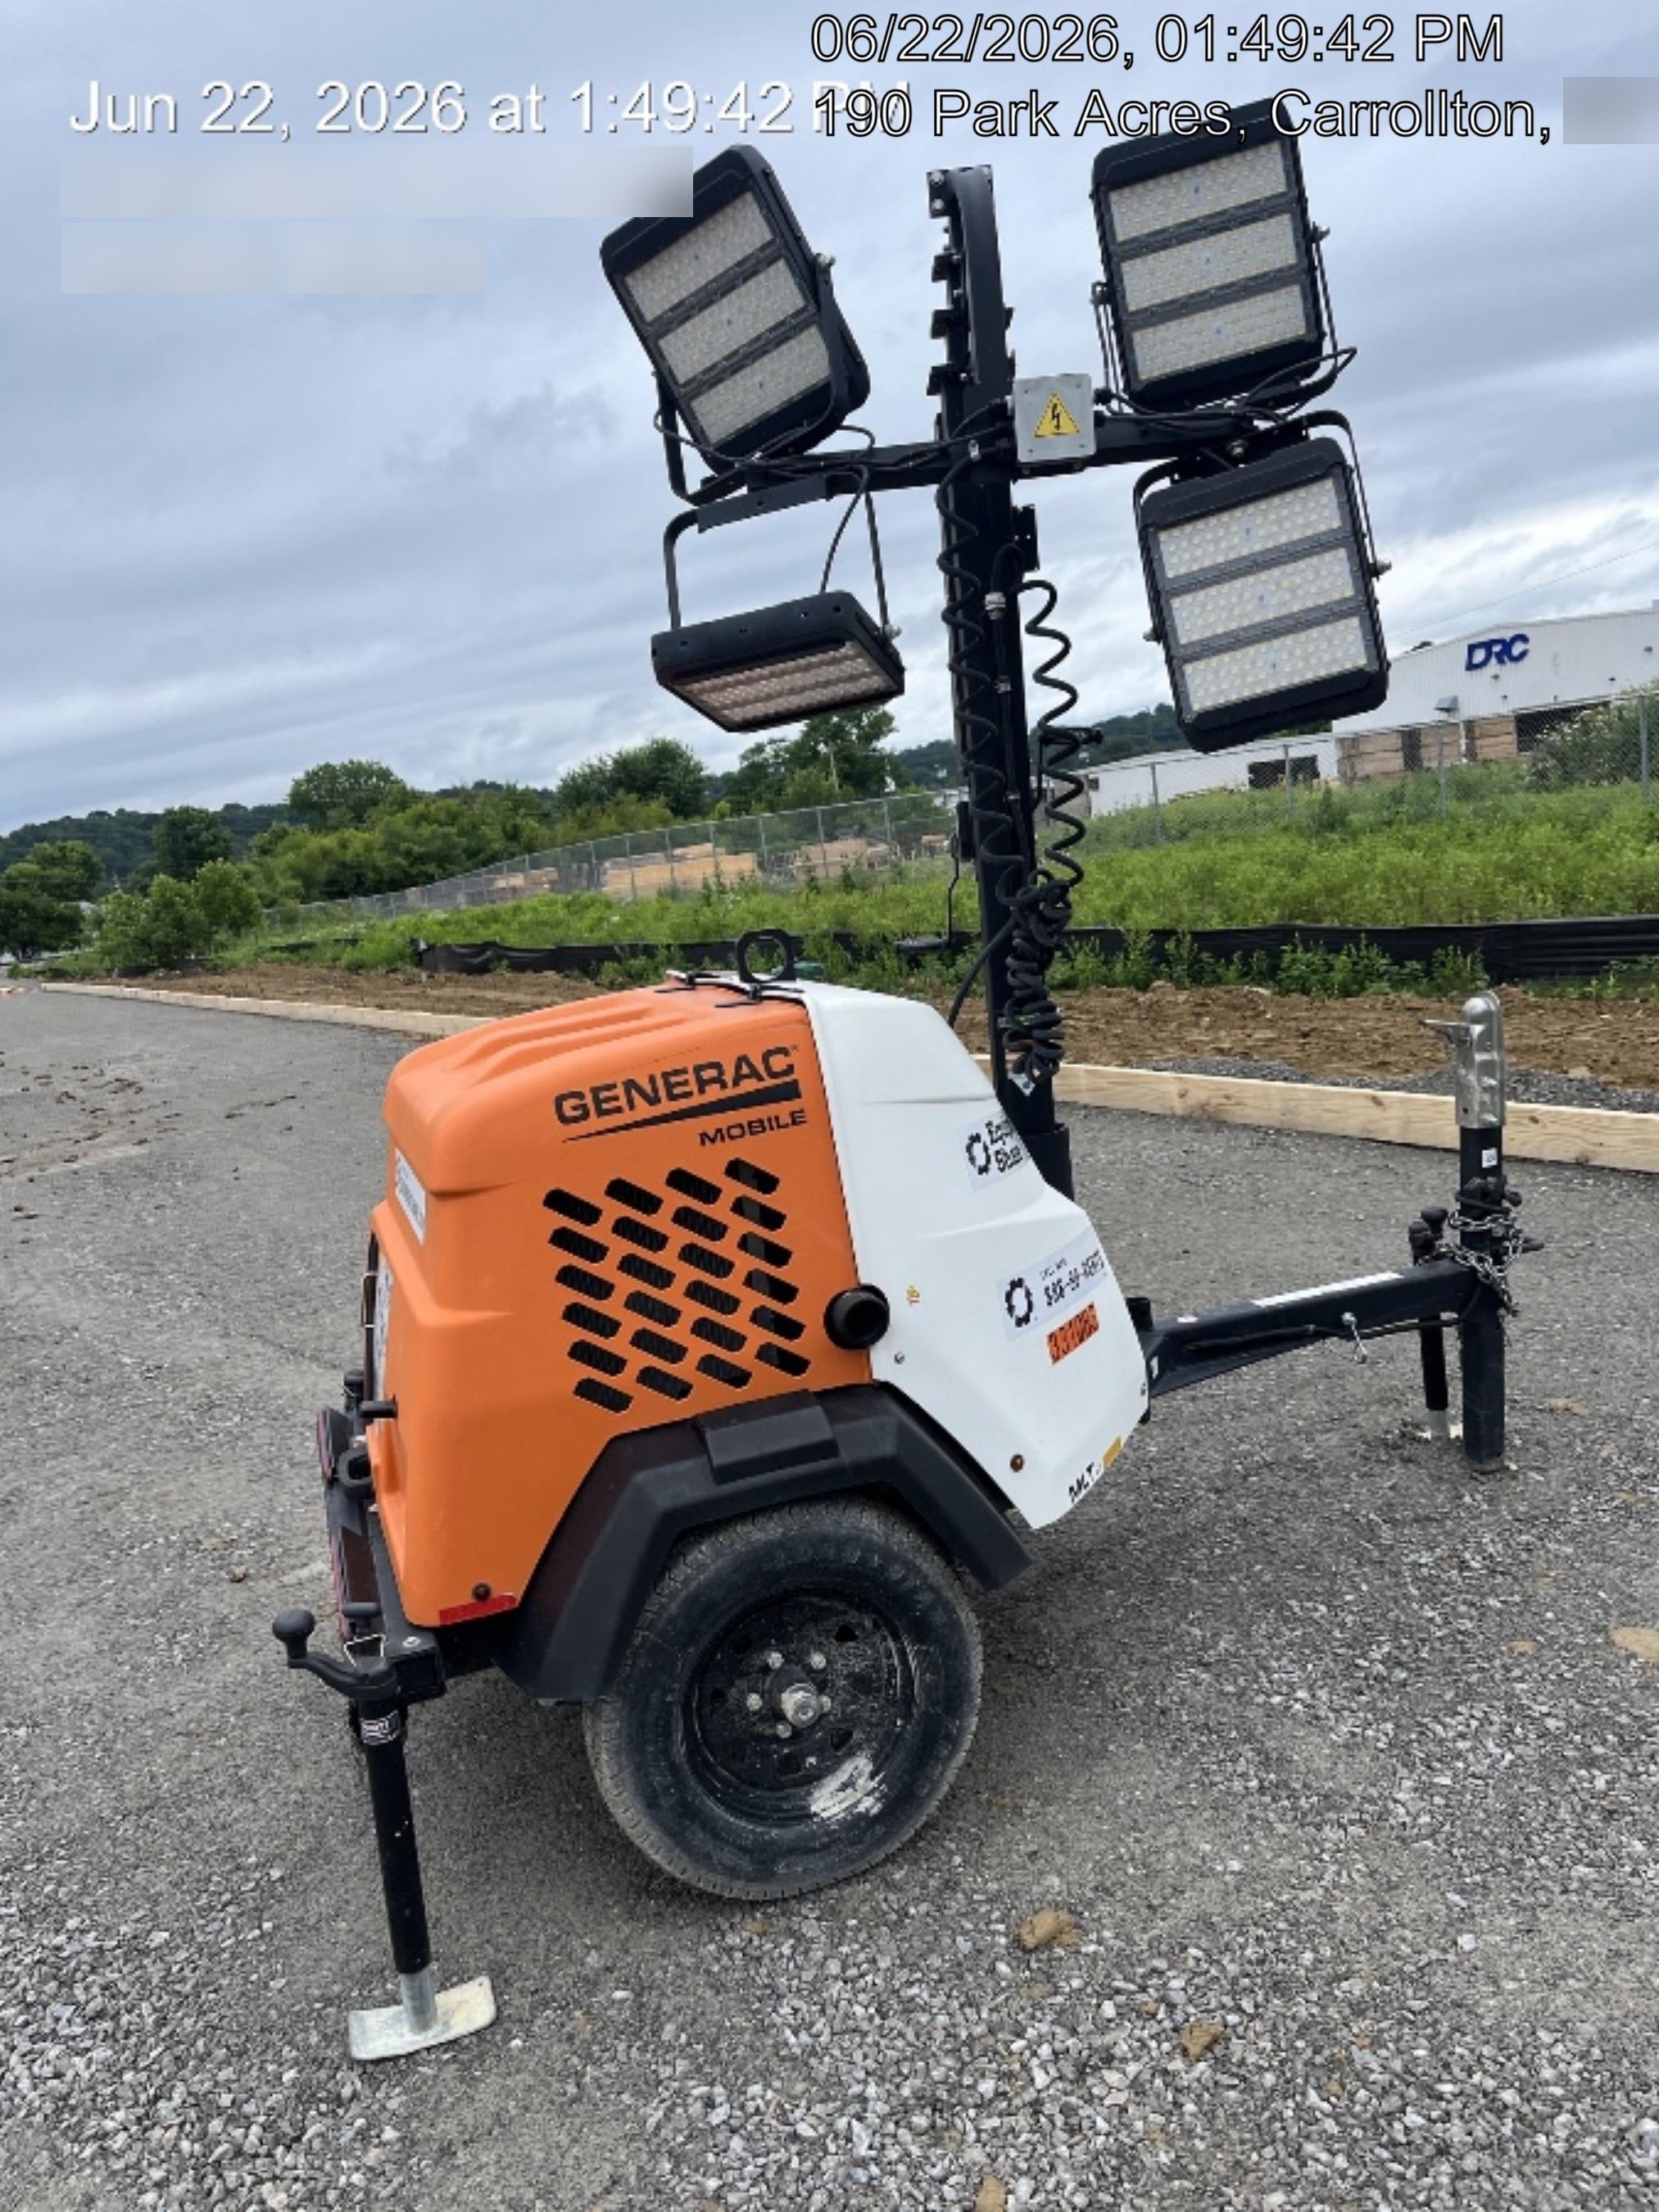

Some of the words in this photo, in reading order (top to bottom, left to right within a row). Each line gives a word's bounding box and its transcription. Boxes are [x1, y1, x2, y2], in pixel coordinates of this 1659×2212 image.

[1465, 633, 1530, 671] DRC
[554, 1046, 796, 1126] GENERAC
[698, 1108, 808, 1147] MOBILE
